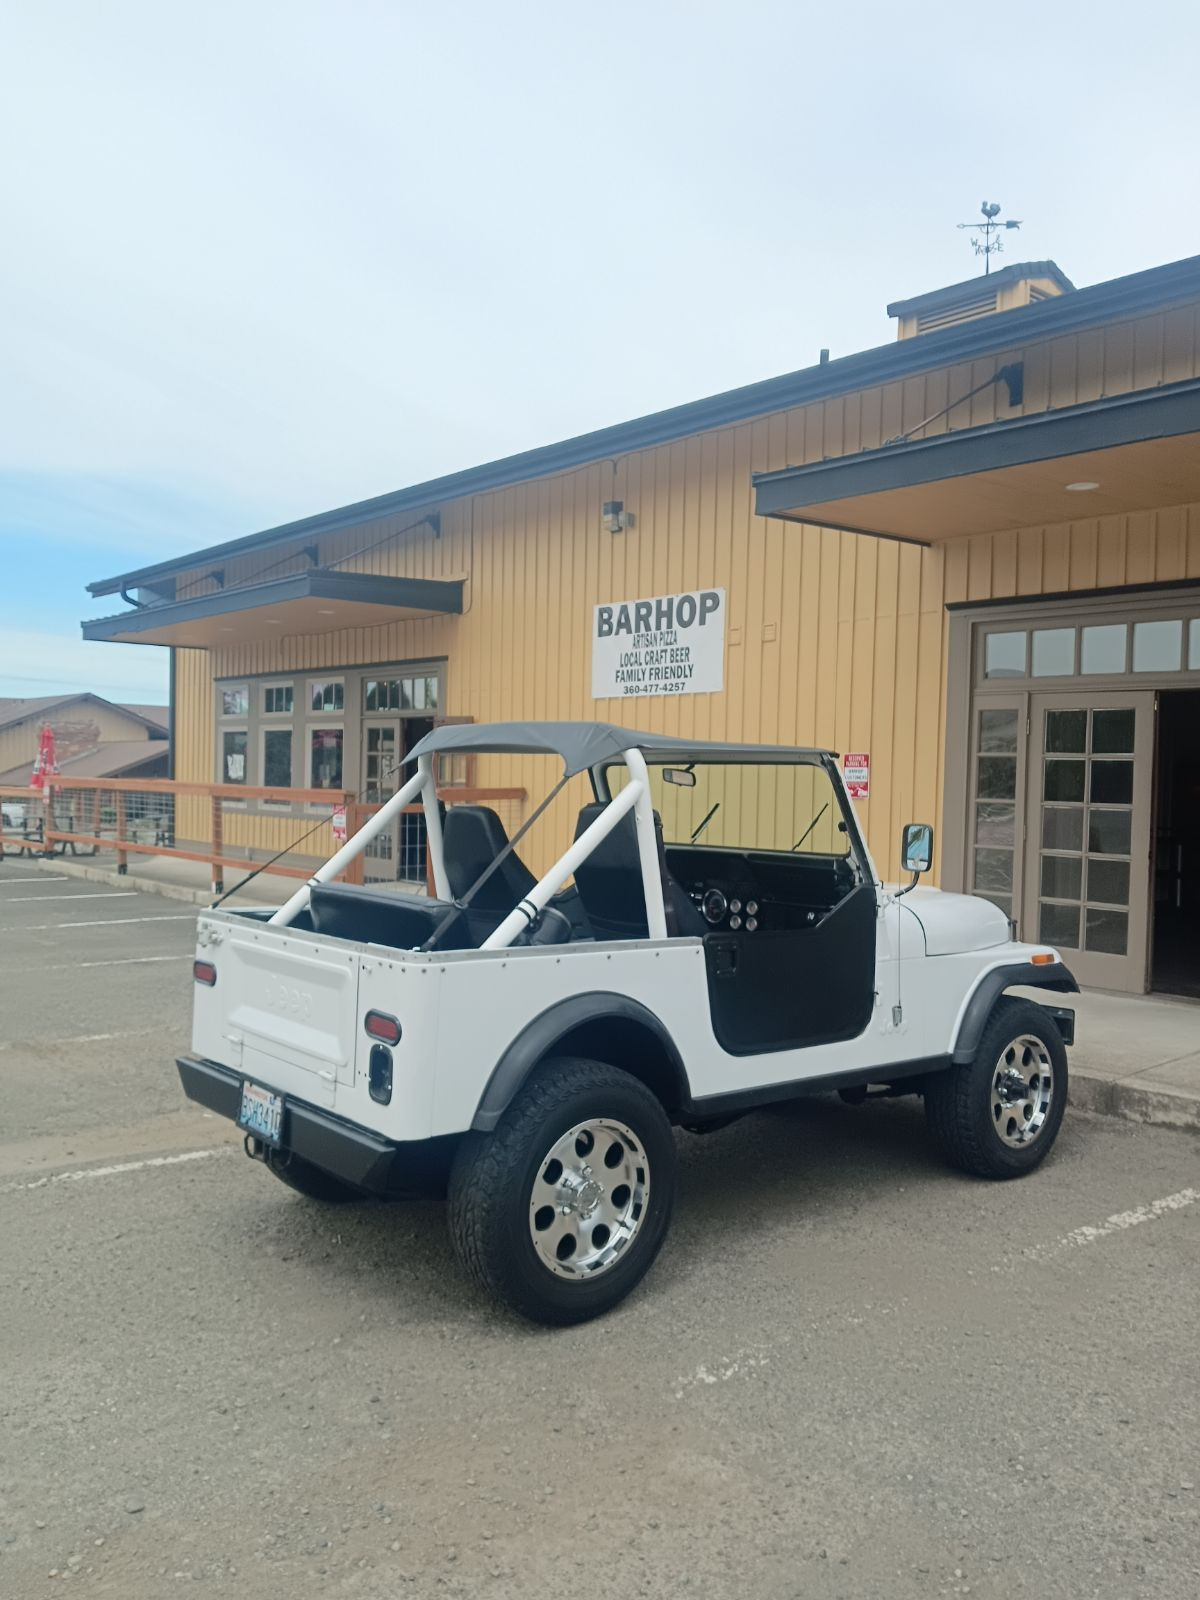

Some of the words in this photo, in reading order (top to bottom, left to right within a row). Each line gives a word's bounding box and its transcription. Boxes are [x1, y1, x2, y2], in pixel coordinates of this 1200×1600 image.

[597, 592, 720, 637] BARHOP
[632, 634, 658, 649] ARTISAN
[659, 630, 678, 646] PIZZA
[620, 650, 642, 668] LOCAL
[644, 648, 668, 666] CRAFT
[669, 646, 690, 664] BEER
[615, 667, 646, 683] FAMILY
[648, 663, 694, 681] FRIENDLY
[623, 682, 686, 695] 360-477-4257
